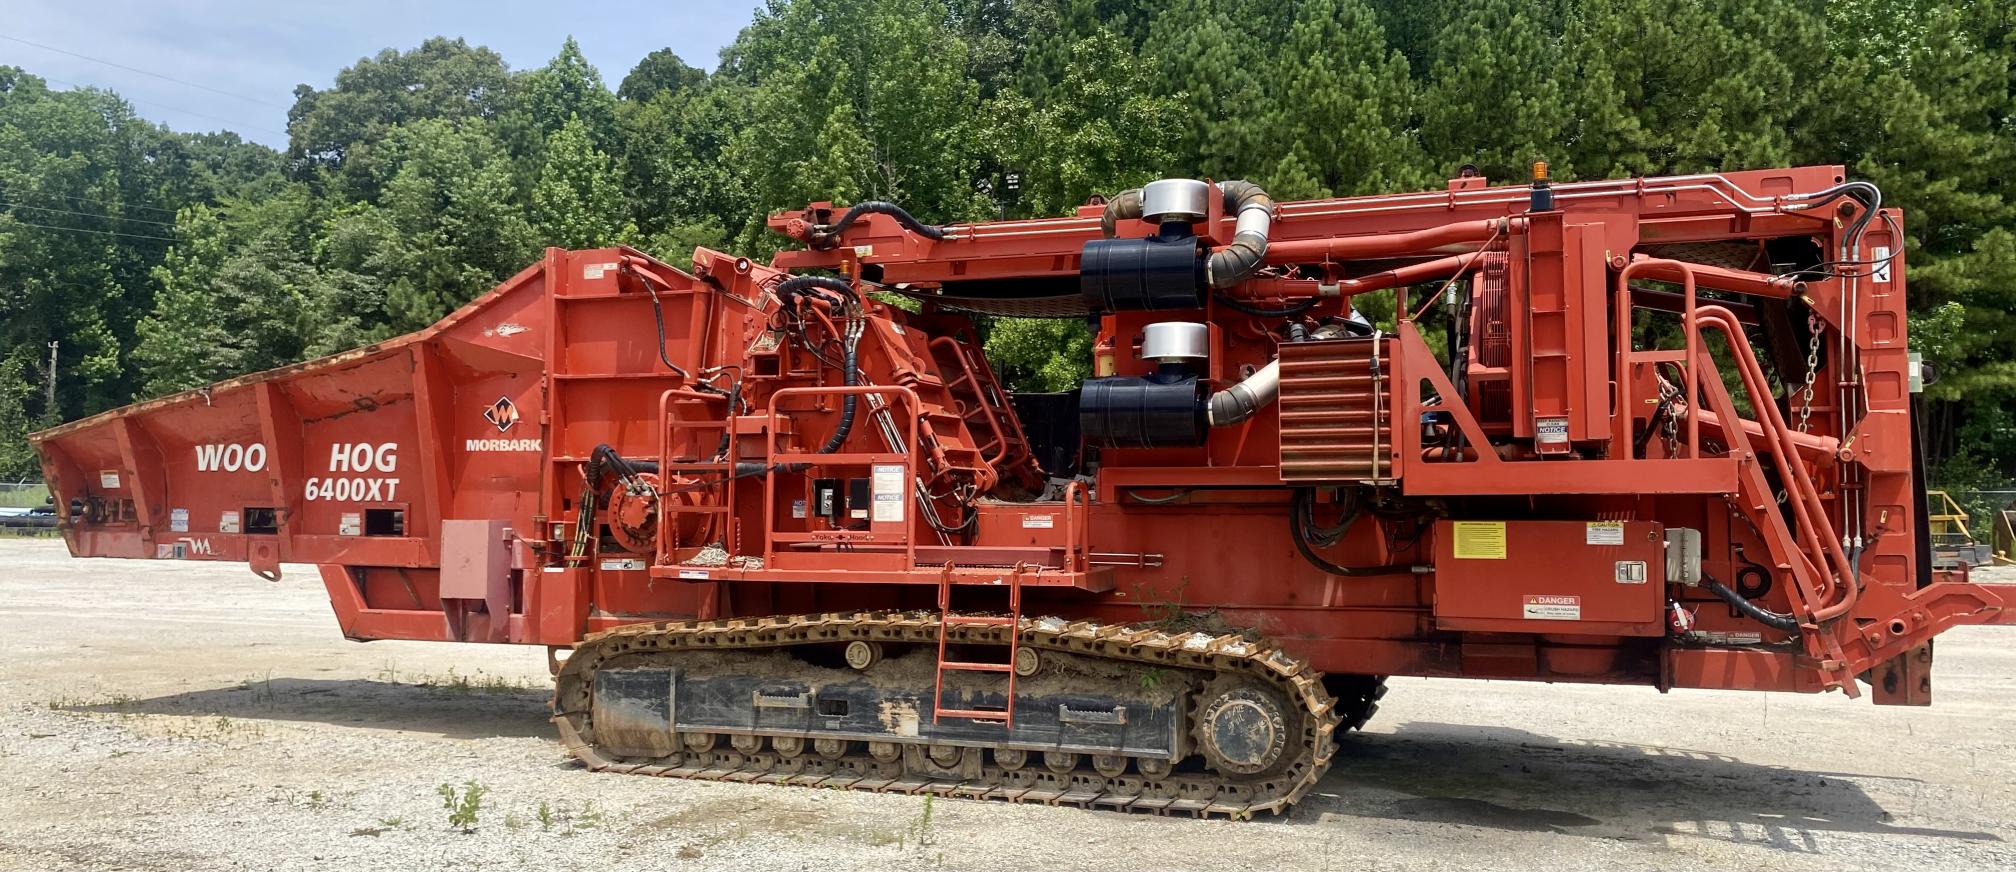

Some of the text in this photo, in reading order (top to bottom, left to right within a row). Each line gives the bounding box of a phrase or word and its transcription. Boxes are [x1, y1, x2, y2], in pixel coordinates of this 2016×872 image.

[195, 442, 397, 472] WOO HOG
[466, 439, 542, 452] MORBARK
[305, 478, 399, 501] 6400XT
